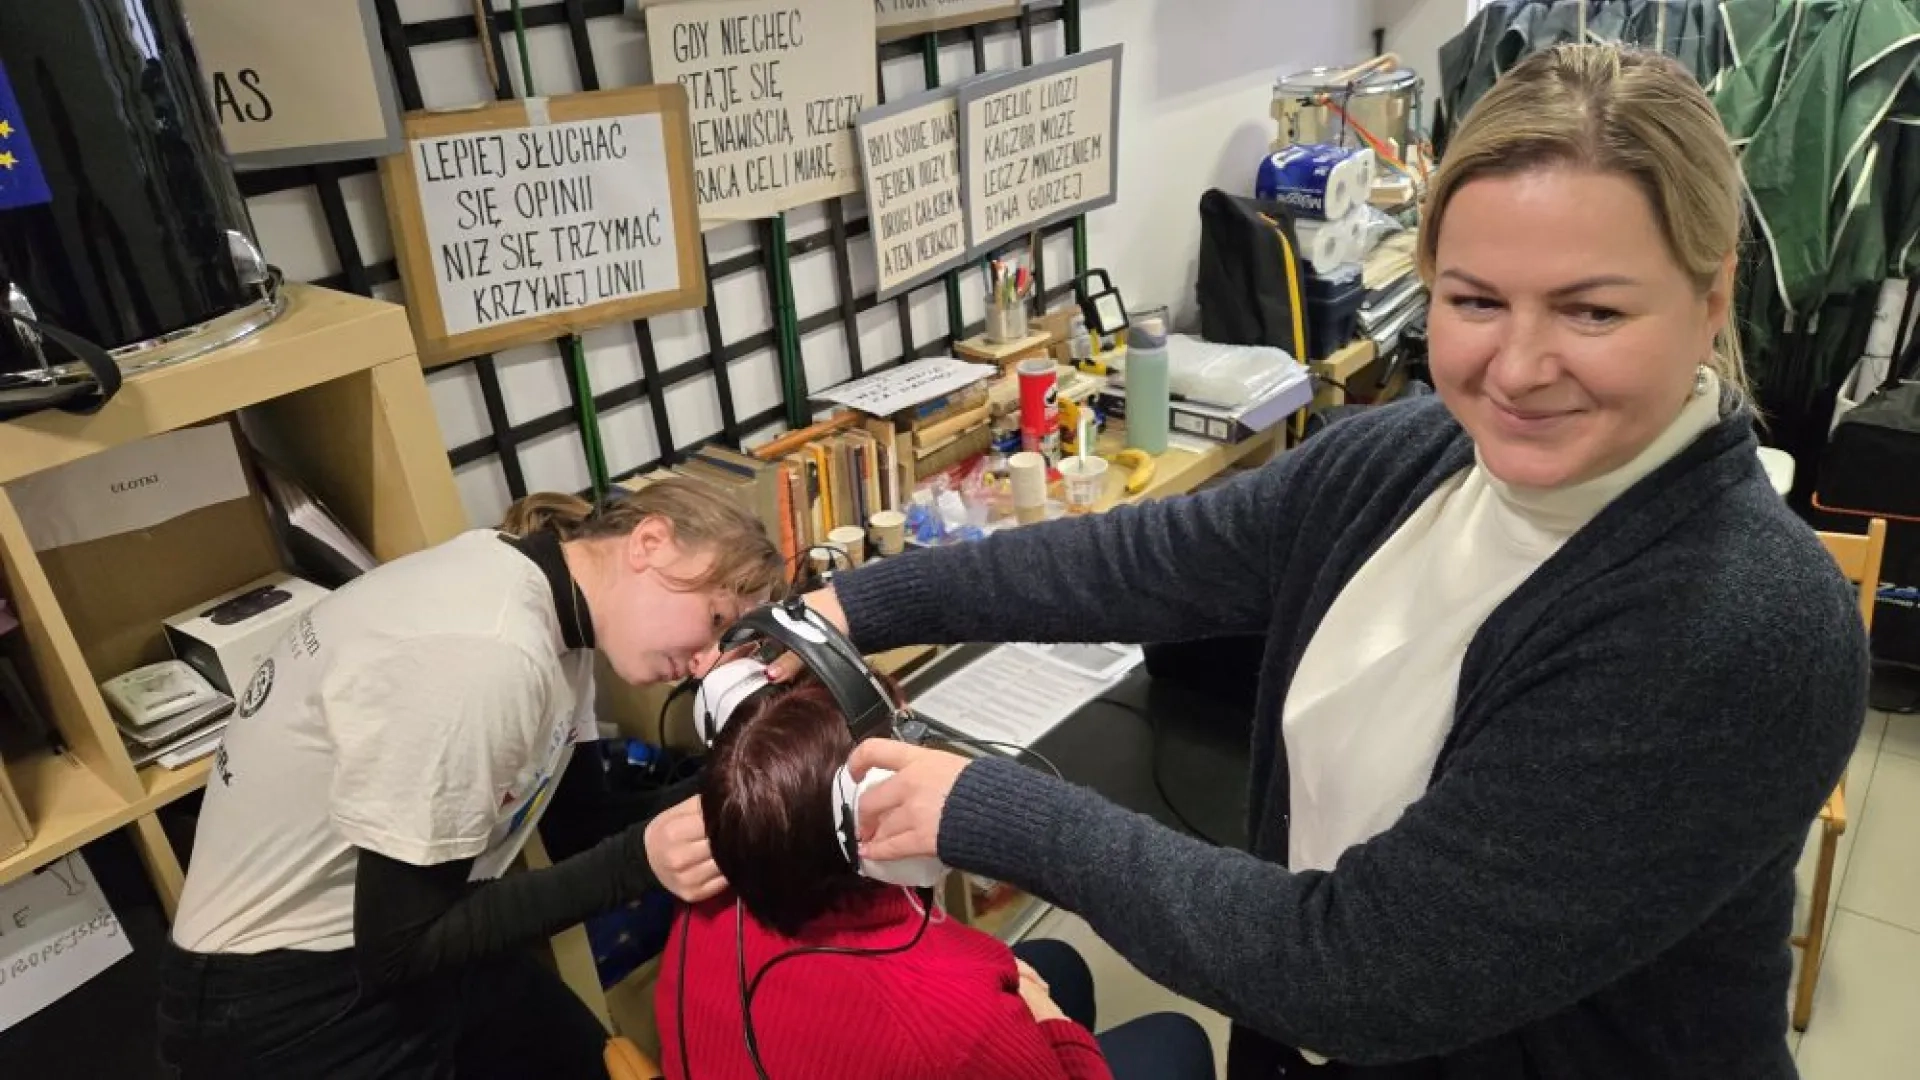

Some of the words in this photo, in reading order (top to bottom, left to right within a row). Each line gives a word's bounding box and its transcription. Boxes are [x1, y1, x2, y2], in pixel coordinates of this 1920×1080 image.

[674, 20, 709, 63] GDY
[750, 60, 783, 101] SIĘ
[1040, 75, 1077, 111] LUDZI
[420, 134, 506, 182] LEPIEJ
[515, 121, 627, 170] SŁUCHAĆ
[692, 107, 793, 158] IENAWIŚCIĄ
[984, 123, 1035, 164] KACZOR
[746, 155, 782, 194] CEL
[875, 166, 916, 208] JEDEN
[984, 162, 1014, 197] LECZ
[1017, 158, 1029, 184] Z
[456, 187, 502, 230] SIĘ
[514, 175, 594, 219] OPINII
[984, 194, 1020, 231] BYWA
[1028, 172, 1082, 211] GORZEJ
[500, 231, 543, 270] SIĘ
[549, 207, 661, 262] TRZYMAĆ
[473, 269, 588, 324] KRZYWEJ
[596, 259, 645, 298] LINII
[110, 473, 159, 494] ULOTKI
